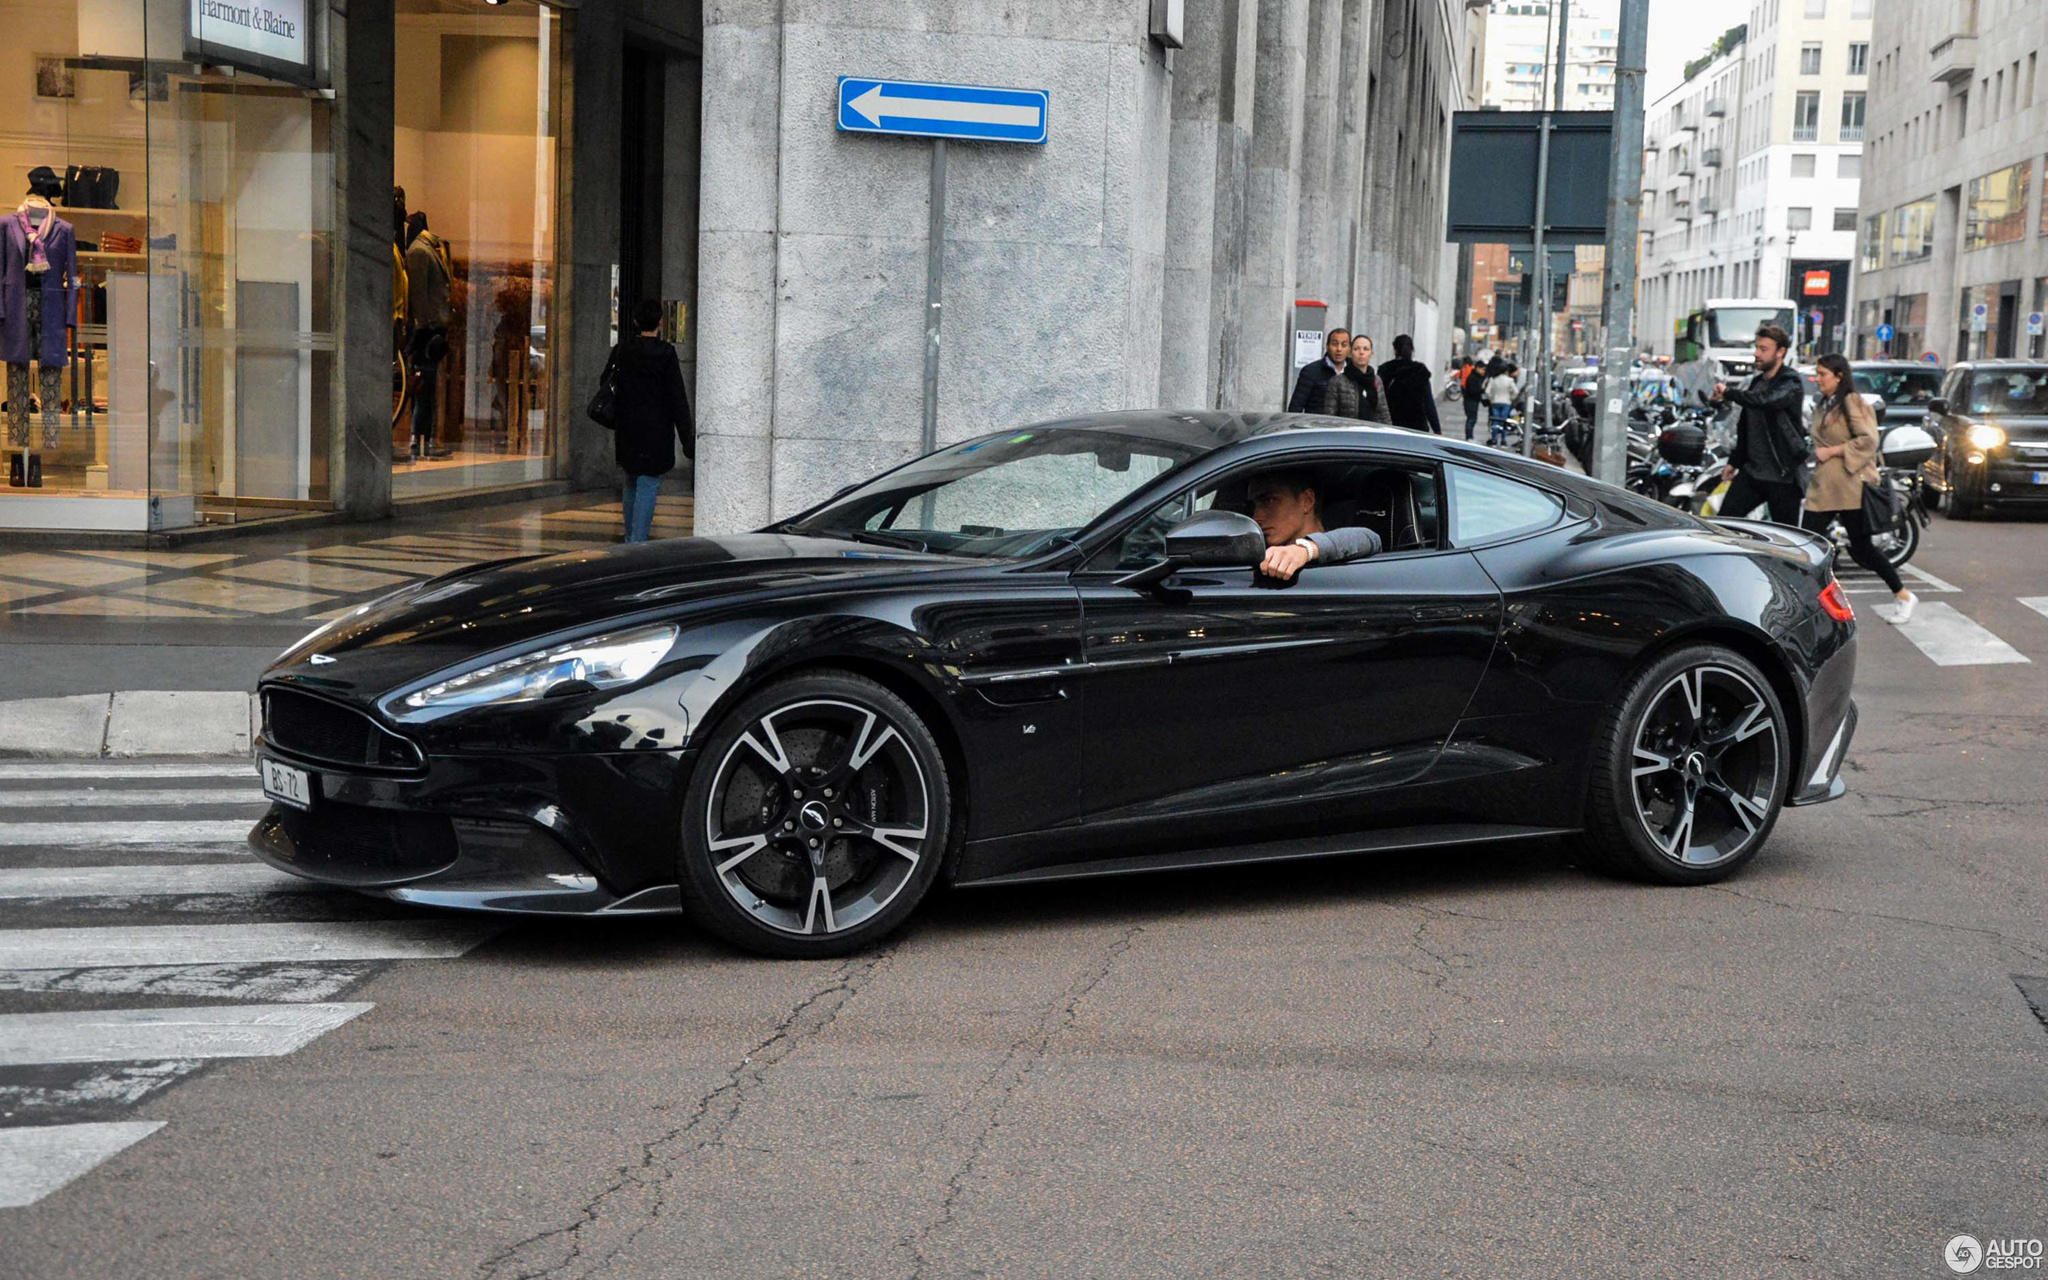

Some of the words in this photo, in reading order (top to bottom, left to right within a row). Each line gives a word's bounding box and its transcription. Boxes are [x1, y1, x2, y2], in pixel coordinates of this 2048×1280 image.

[201, 0, 251, 27] Harmont
[252, 7, 263, 31] &
[263, 9, 295, 39] Blaine
